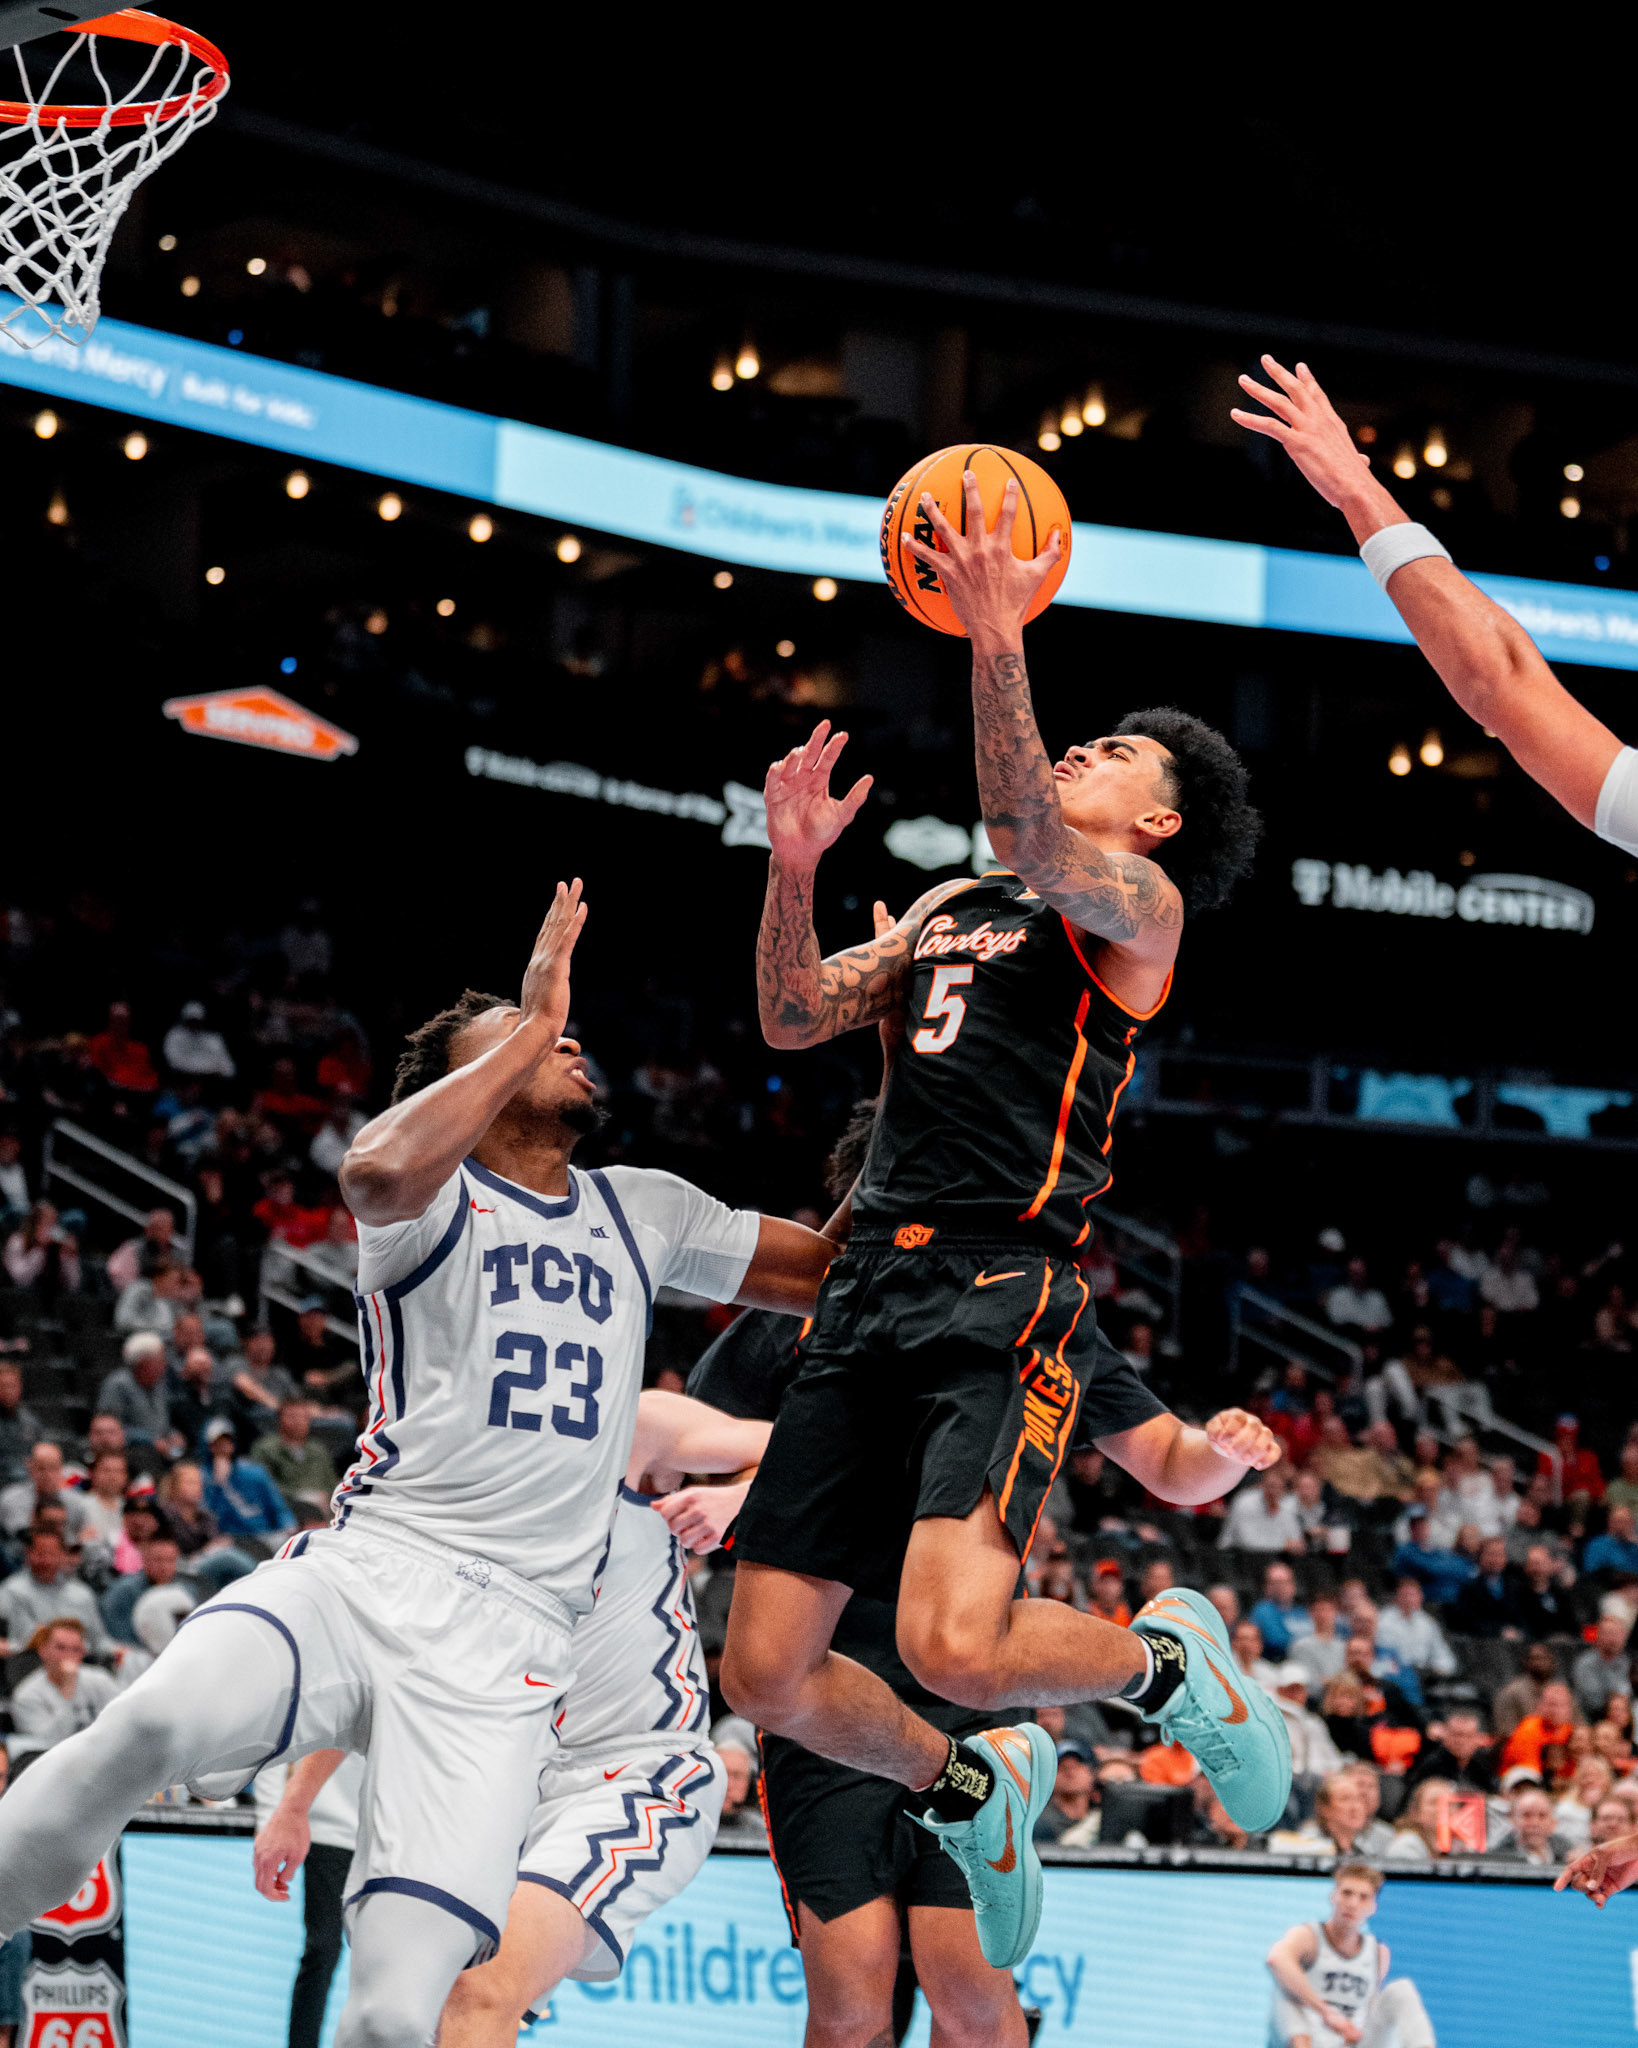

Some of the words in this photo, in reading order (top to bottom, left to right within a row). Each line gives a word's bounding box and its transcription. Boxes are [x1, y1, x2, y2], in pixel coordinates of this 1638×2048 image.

[1332, 862, 1456, 919] Mobile
[1457, 880, 1590, 934] CENTER
[914, 914, 1027, 961] Cowboys
[912, 964, 974, 1054] 5
[894, 1223, 935, 1249] OSU
[483, 1242, 615, 1325] TCU
[488, 1331, 604, 1441] 23
[1023, 1357, 1073, 1461] POKES
[32, 1984, 109, 2007] PHILLIPS
[38, 2018, 106, 2048] 66
